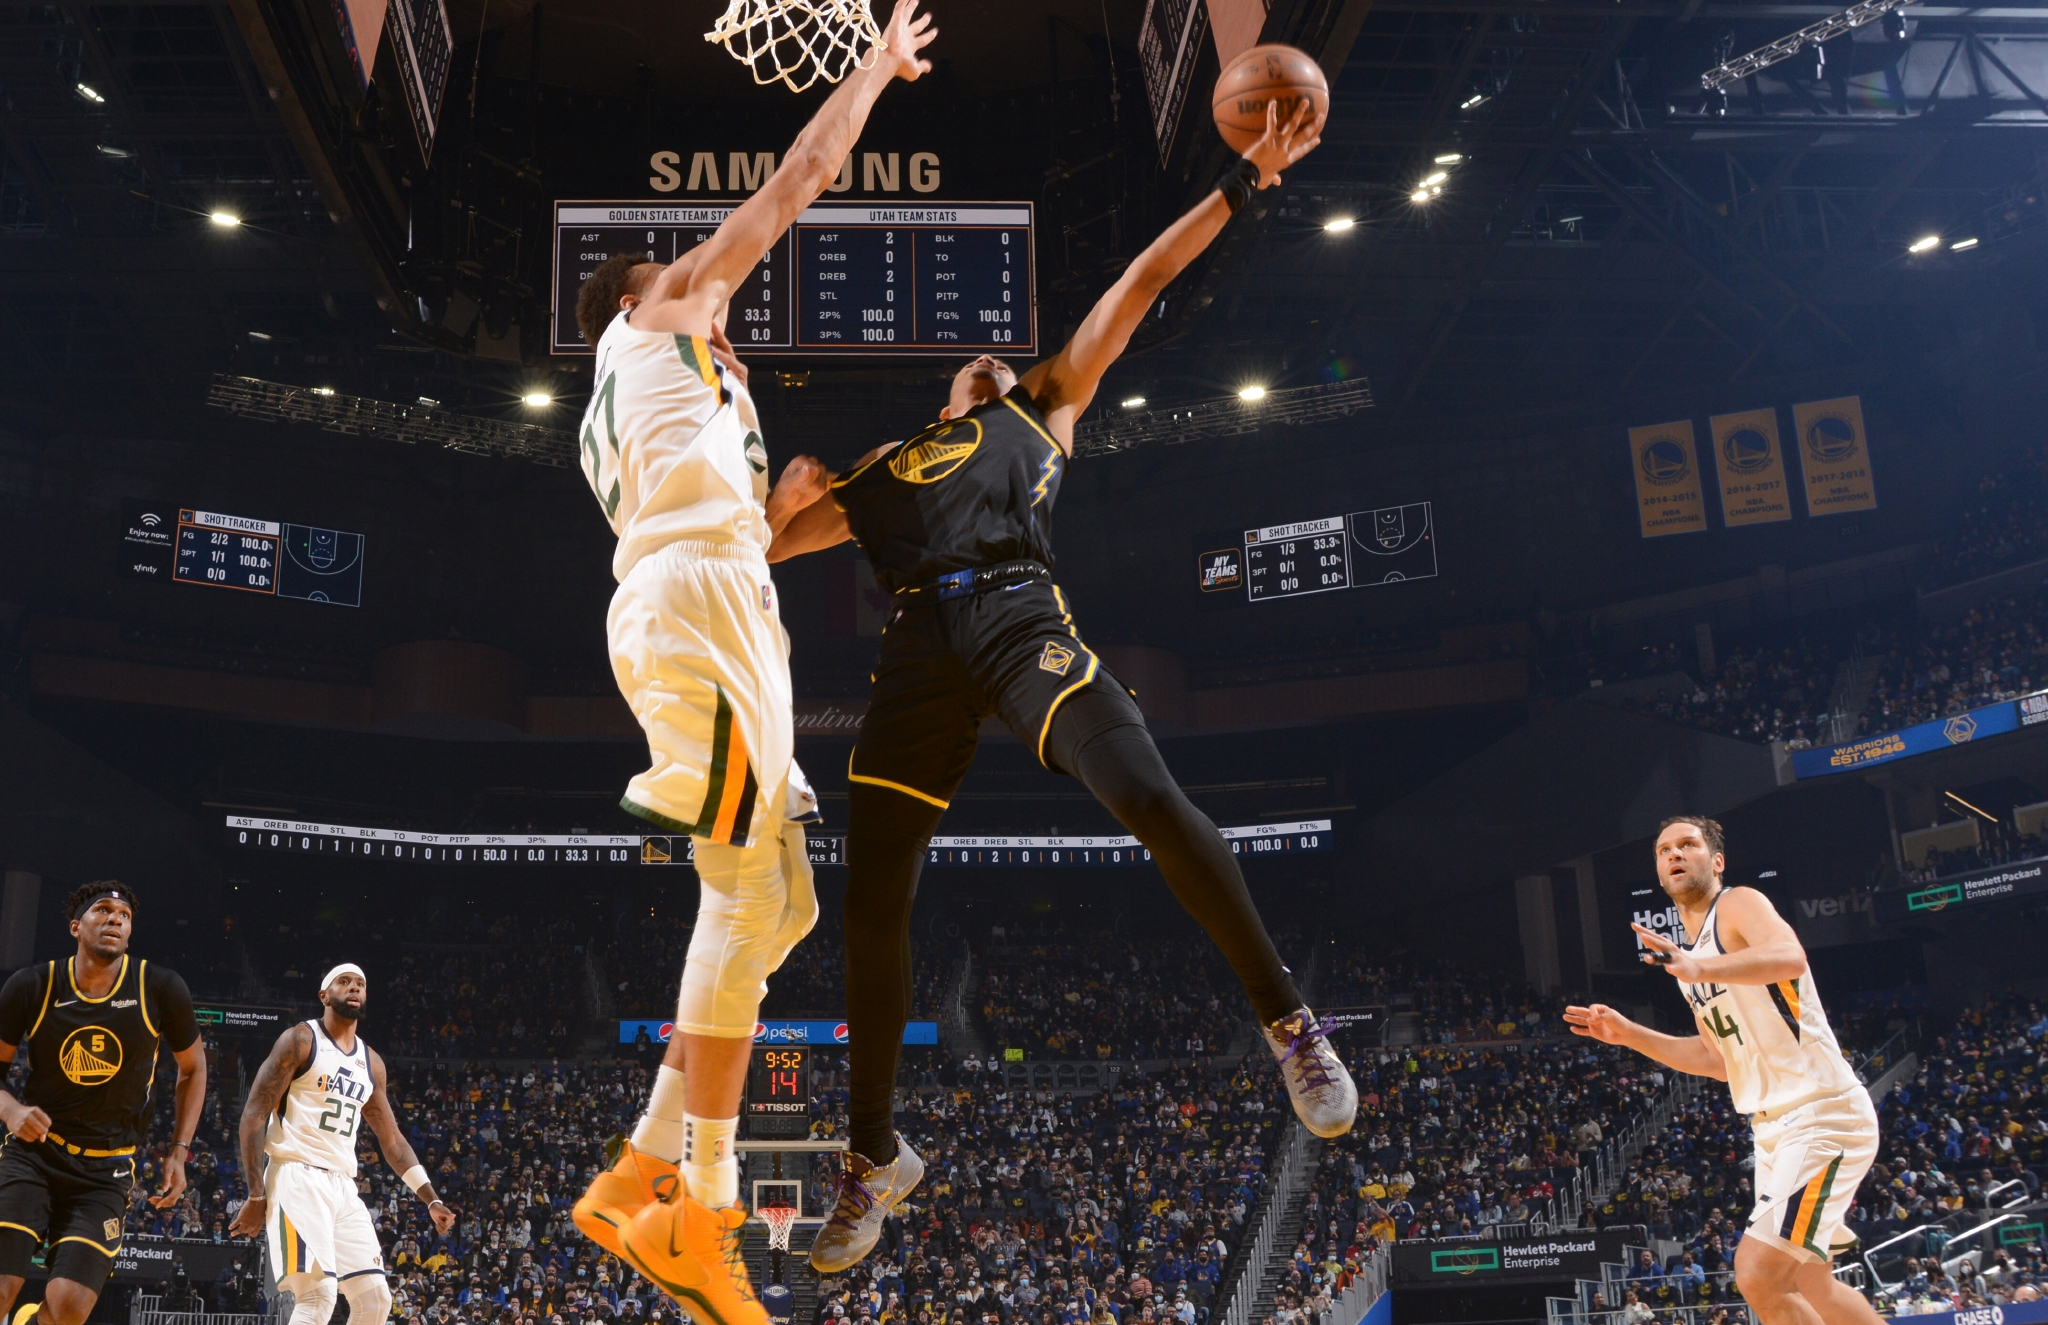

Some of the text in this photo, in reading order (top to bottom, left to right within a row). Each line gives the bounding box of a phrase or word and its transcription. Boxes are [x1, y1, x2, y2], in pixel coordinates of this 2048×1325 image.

[650, 150, 941, 193] SAMNG
[609, 210, 709, 221] GOLDEN STATE TEAM
[869, 211, 957, 222] UTAH TEAM STATS
[581, 232, 655, 244] AST 0
[820, 232, 894, 244] AST 2
[936, 232, 1009, 245] BLK 0
[580, 253, 608, 261] OREB
[820, 251, 894, 263] OREB 0
[936, 252, 1010, 264] TO 1
[763, 270, 770, 282] 0
[820, 270, 894, 282] DREB 2
[936, 271, 1010, 283] POT 0
[763, 290, 770, 302] 0
[820, 290, 894, 302] STL 0
[936, 290, 1010, 302] PITP 0
[745, 309, 770, 322] 33.3
[820, 310, 894, 322] 2P% 100.0
[936, 310, 1011, 322] FG% 100.0
[752, 328, 770, 341] 0.0
[820, 329, 894, 342] 3P% 100.0
[937, 330, 1012, 342] FT% 0.0
[1810, 470, 1866, 484] 2017-2018
[1726, 481, 1780, 494] 2016-2017
[1830, 486, 1850, 495] NBA
[1644, 492, 1696, 506] 2014-2015
[1814, 492, 1870, 506] CHAMPIONS
[1662, 508, 1681, 517] NBA
[1730, 504, 1784, 517] CHAMPIONS
[204, 513, 266, 532] SHOT TRACKER
[1646, 514, 1700, 527] CHAMPIONS
[129, 528, 169, 540] Enjoy now:
[1268, 520, 1330, 538] SHOT TRACKER
[211, 533, 228, 546] 2/2
[181, 549, 196, 558] 3PT
[211, 551, 225, 563] 1/1
[1280, 544, 1296, 556] 1/3
[1214, 555, 1230, 567] MY
[133, 563, 158, 574] xfinity
[207, 568, 226, 581] 0/0
[1205, 564, 1238, 578] TEAMS
[1252, 568, 1267, 576] 3PT
[1280, 561, 1295, 574] 0/1
[1281, 578, 1299, 591] 0/0
[1834, 734, 1900, 756] WARRIORS
[264, 821, 288, 829] OREB
[295, 824, 320, 832] DREB
[360, 830, 376, 838] BLK
[1256, 822, 1318, 834] FG% FT%
[240, 832, 628, 862] 0 0 0 1 0 0 0 0 50.0 0.0 33.3 0.0
[831, 839, 837, 850] 7
[1252, 838, 1282, 852] 100.0
[1300, 836, 1318, 849] 0.0
[830, 852, 837, 862] 0
[931, 851, 938, 862] 2
[962, 851, 968, 862] 0
[992, 851, 998, 862] 2
[1022, 851, 1029, 862] 0
[1052, 851, 1060, 862] 0
[1084, 852, 1089, 862] 1
[1113, 851, 1120, 862] 0
[1964, 867, 2042, 890] Hewlett Packard
[1966, 883, 2013, 900] Enterprise
[1634, 906, 1682, 928] Holi
[111, 999, 138, 1008] Rakuten
[226, 1012, 252, 1020] Hewlett
[226, 1018, 258, 1026] Enterprise
[92, 1035, 104, 1052] 5
[766, 1052, 802, 1068] 9:52
[772, 1072, 796, 1096] 14
[766, 1103, 806, 1112] TISSOT
[318, 1098, 356, 1138] 23
[130, 1247, 173, 1260] Packard
[1504, 1240, 1596, 1256] Hewlett Packard
[1504, 1256, 1560, 1269] Enterprise
[1954, 1310, 1993, 1325] CHASE
